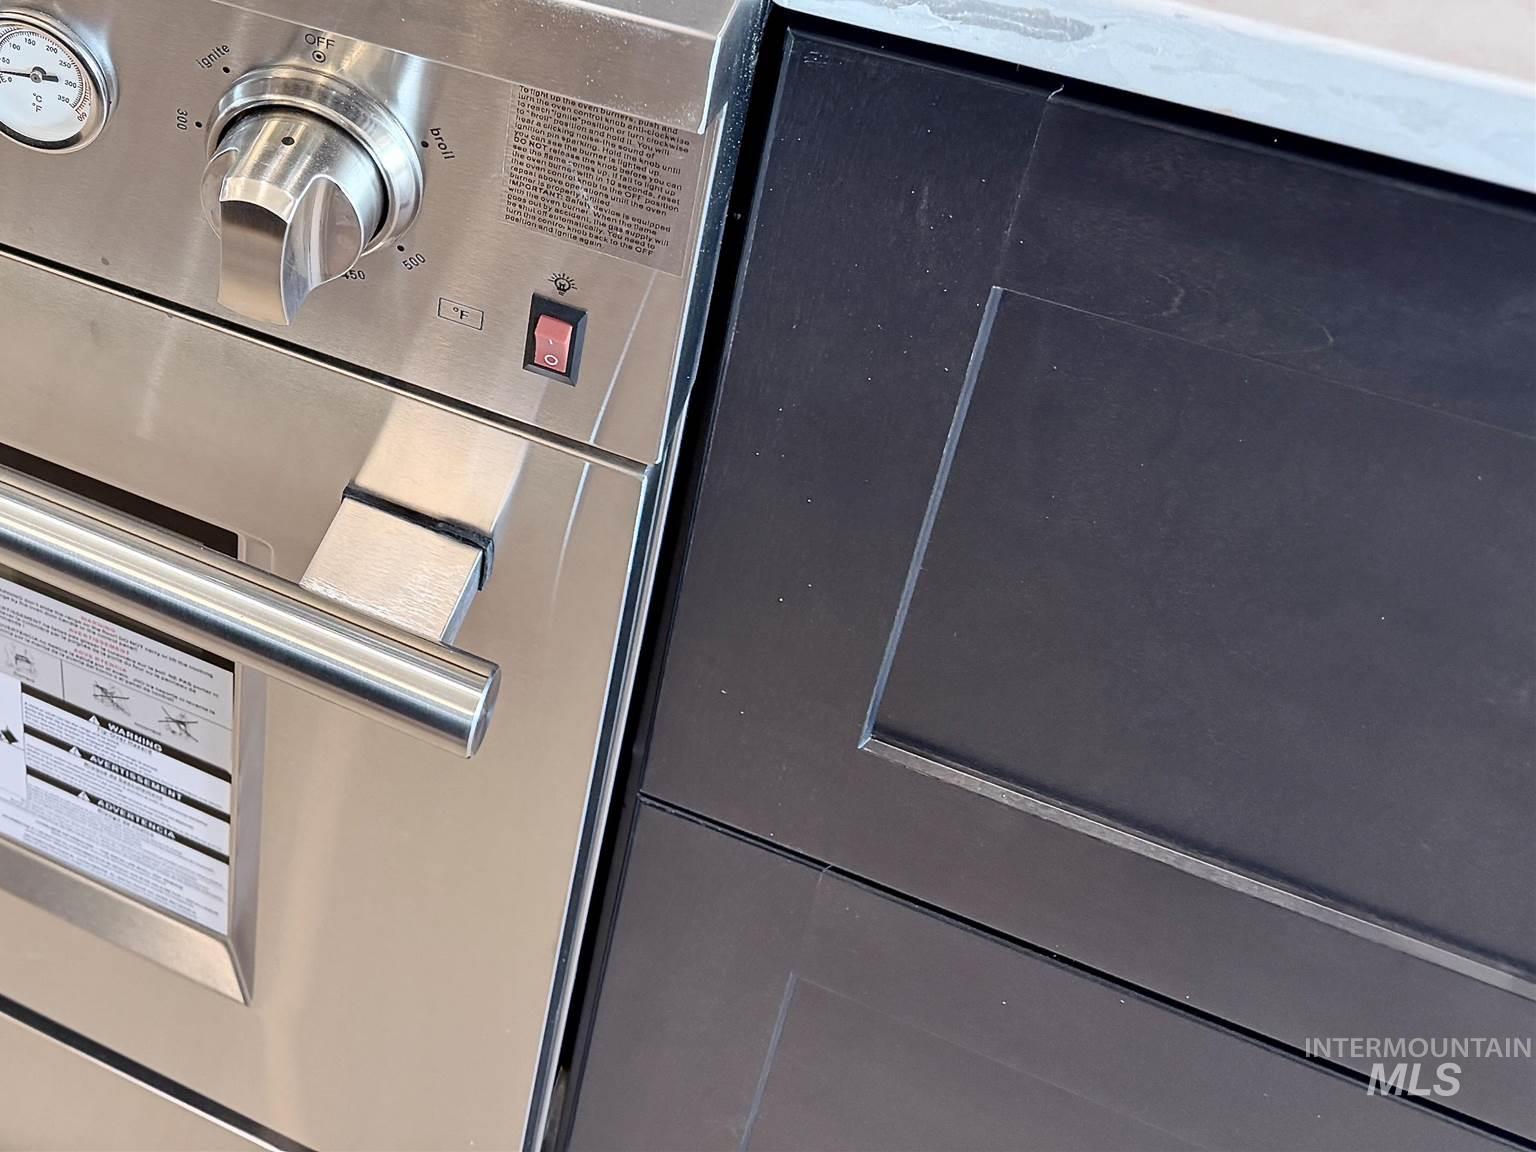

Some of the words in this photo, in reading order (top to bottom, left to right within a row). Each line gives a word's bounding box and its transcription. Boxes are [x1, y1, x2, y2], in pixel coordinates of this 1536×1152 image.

[9, 42, 21, 51] 100
[24, 37, 36, 46] 150
[304, 33, 336, 50] OFF
[45, 44, 58, 54] 200
[1, 56, 10, 65] 50
[59, 59, 72, 69] 250
[64, 79, 77, 89] 300
[57, 94, 70, 104] 350
[176, 108, 188, 131] 300
[429, 127, 455, 160] broil
[402, 253, 426, 271] 500
[452, 306, 470, 320] °F
[108, 721, 162, 753] WARNING
[89, 753, 181, 801] AVERTISSEMENT
[97, 798, 175, 839] ADVERTENCIA
